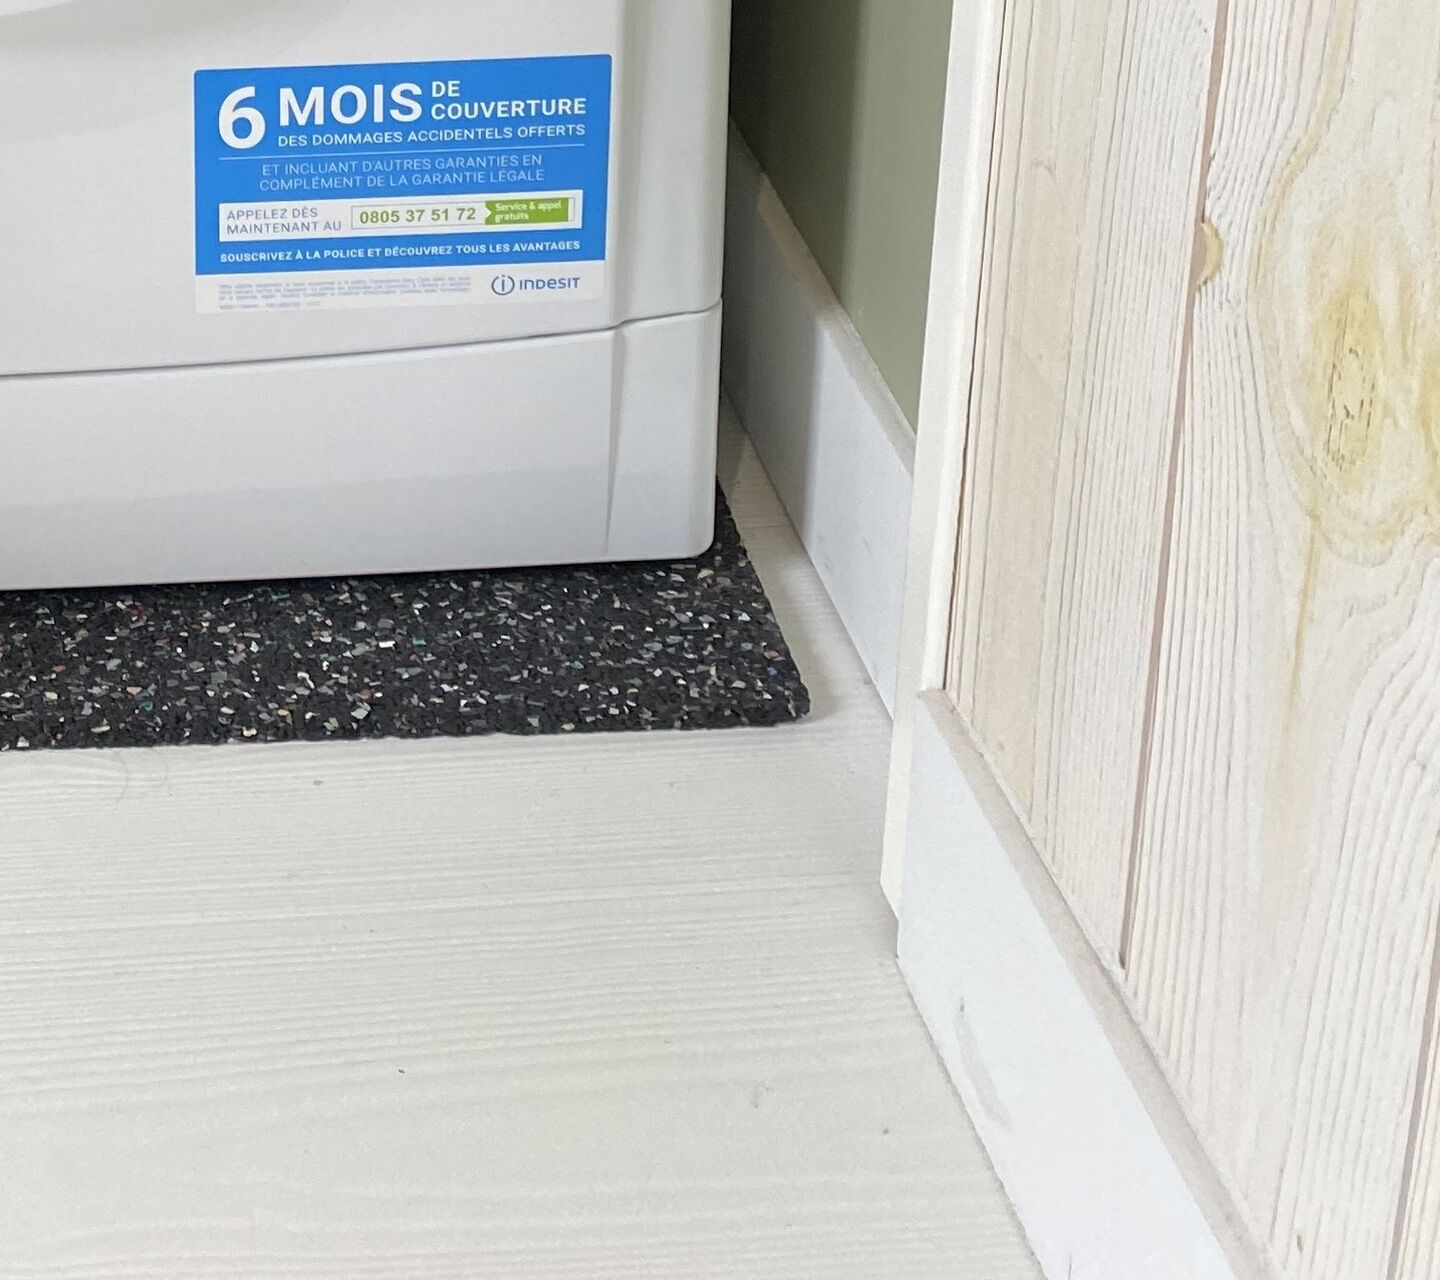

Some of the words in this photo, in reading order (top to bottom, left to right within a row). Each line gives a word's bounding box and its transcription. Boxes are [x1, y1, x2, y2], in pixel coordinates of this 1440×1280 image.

[431, 81, 460, 97] DE
[218, 86, 266, 149] 6
[279, 82, 422, 127] MOIS
[431, 97, 587, 120] COUVERTURE
[278, 135, 307, 147] DES
[312, 132, 403, 146] DOMMAGES
[407, 127, 513, 142] ACCIDENTELS
[517, 124, 586, 138] OFFERTS
[262, 164, 280, 176] ET
[285, 161, 358, 175] INCLUANT
[435, 155, 518, 169] GARANTIES
[523, 154, 542, 166] EN
[260, 175, 362, 191] COMPLÉMENT
[367, 175, 385, 187] DE
[390, 174, 408, 186] LA
[412, 171, 486, 185] GARANTIE
[490, 168, 544, 182] LÉGALE
[227, 207, 288, 221] APPELEZ
[292, 205, 318, 218] DÈS
[359, 210, 400, 224] 0805
[405, 209, 425, 222] 37
[431, 208, 449, 221] 51
[457, 207, 476, 220] 72
[495, 202, 527, 211] Service
[538, 201, 562, 212] appel
[495, 212, 529, 223] gratuits
[227, 221, 319, 235] MAINTENANT
[323, 221, 342, 231] AU
[220, 250, 292, 263] SOUSCRIVEZ
[306, 249, 321, 260] LA
[324, 248, 364, 259] POLICE
[367, 247, 382, 257] ET
[385, 245, 453, 257] DÉCOUVREZ
[456, 243, 486, 254] TOUS
[489, 242, 509, 253] LES
[512, 240, 581, 252] AVANTAGES
